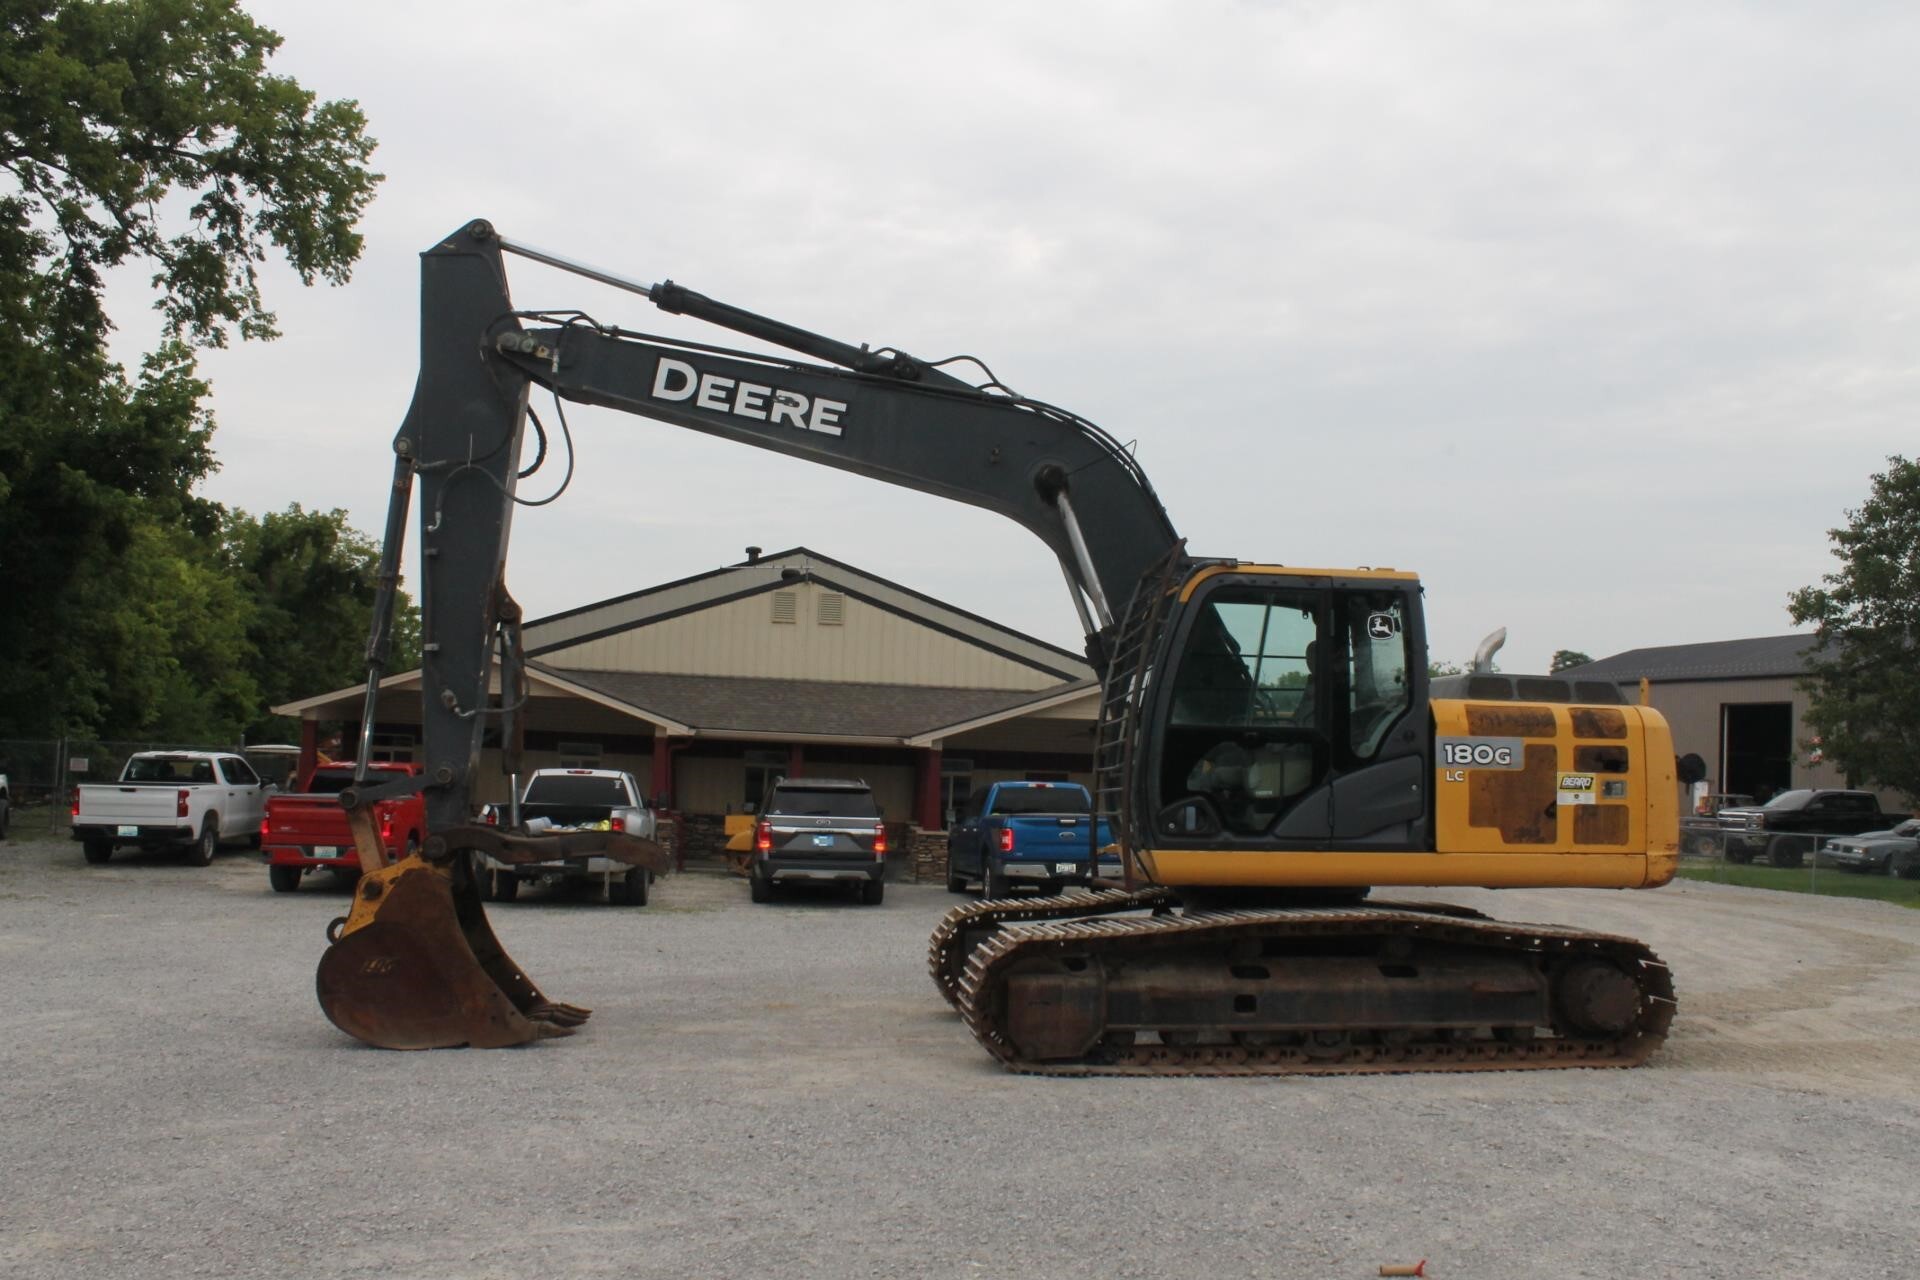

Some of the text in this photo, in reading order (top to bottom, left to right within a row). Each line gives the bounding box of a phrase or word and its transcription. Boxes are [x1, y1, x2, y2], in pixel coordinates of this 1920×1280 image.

[652, 357, 847, 436] DEERE
[1444, 744, 1510, 765] 180G
[1446, 770, 1464, 781] LC
[1562, 777, 1592, 789] BEARD
